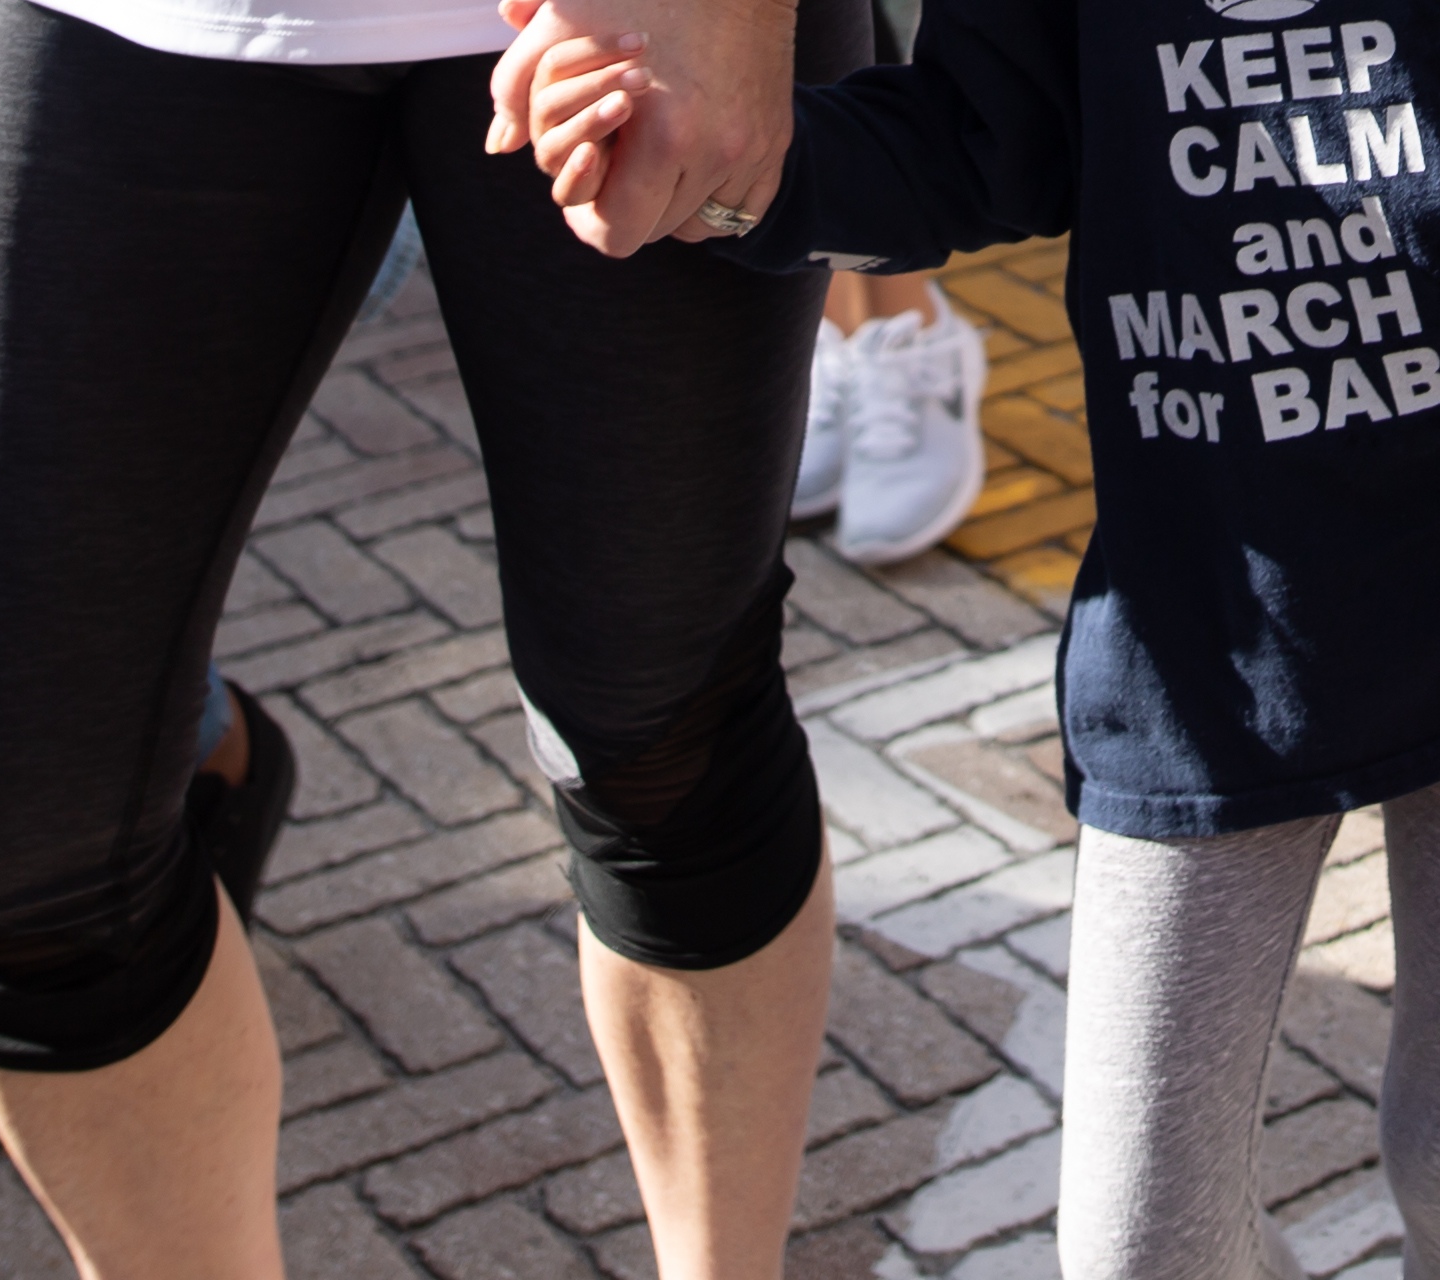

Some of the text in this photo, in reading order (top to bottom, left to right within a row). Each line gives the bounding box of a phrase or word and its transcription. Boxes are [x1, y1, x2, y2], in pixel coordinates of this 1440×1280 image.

[1156, 19, 1397, 113] KEEP
[1168, 102, 1427, 197] CALM
[1232, 196, 1398, 276] and
[1108, 270, 1423, 363] MARCH
[1129, 371, 1224, 443] for
